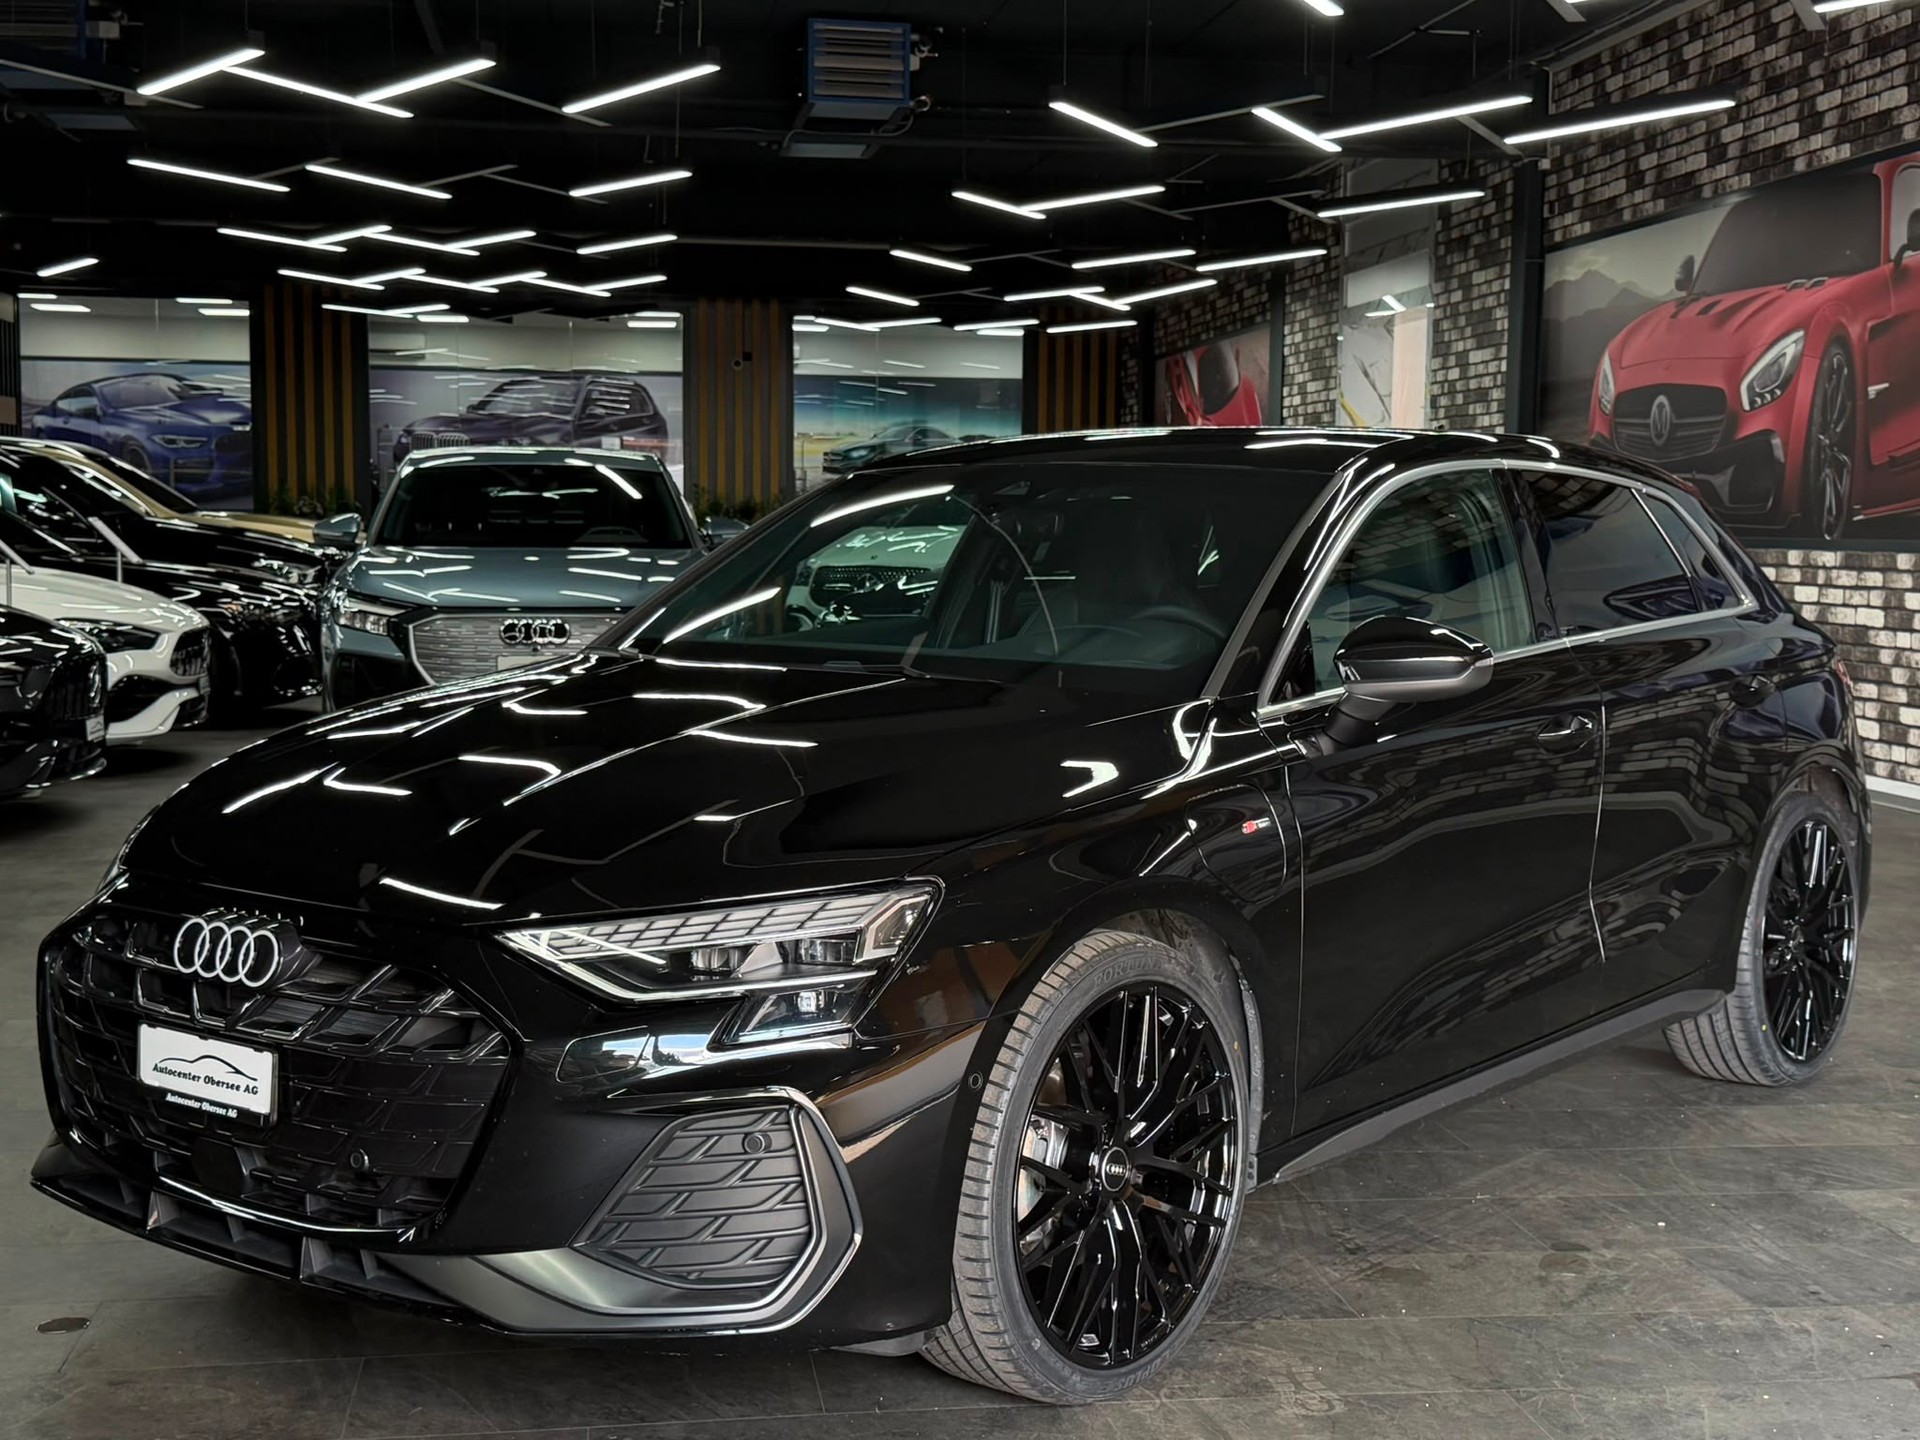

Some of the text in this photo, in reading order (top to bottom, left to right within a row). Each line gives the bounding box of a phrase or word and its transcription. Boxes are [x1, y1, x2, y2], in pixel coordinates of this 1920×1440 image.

[152, 1063, 259, 1095] Autocenter Obersee AG
[165, 1092, 238, 1118] Autocenter Obersee AG
